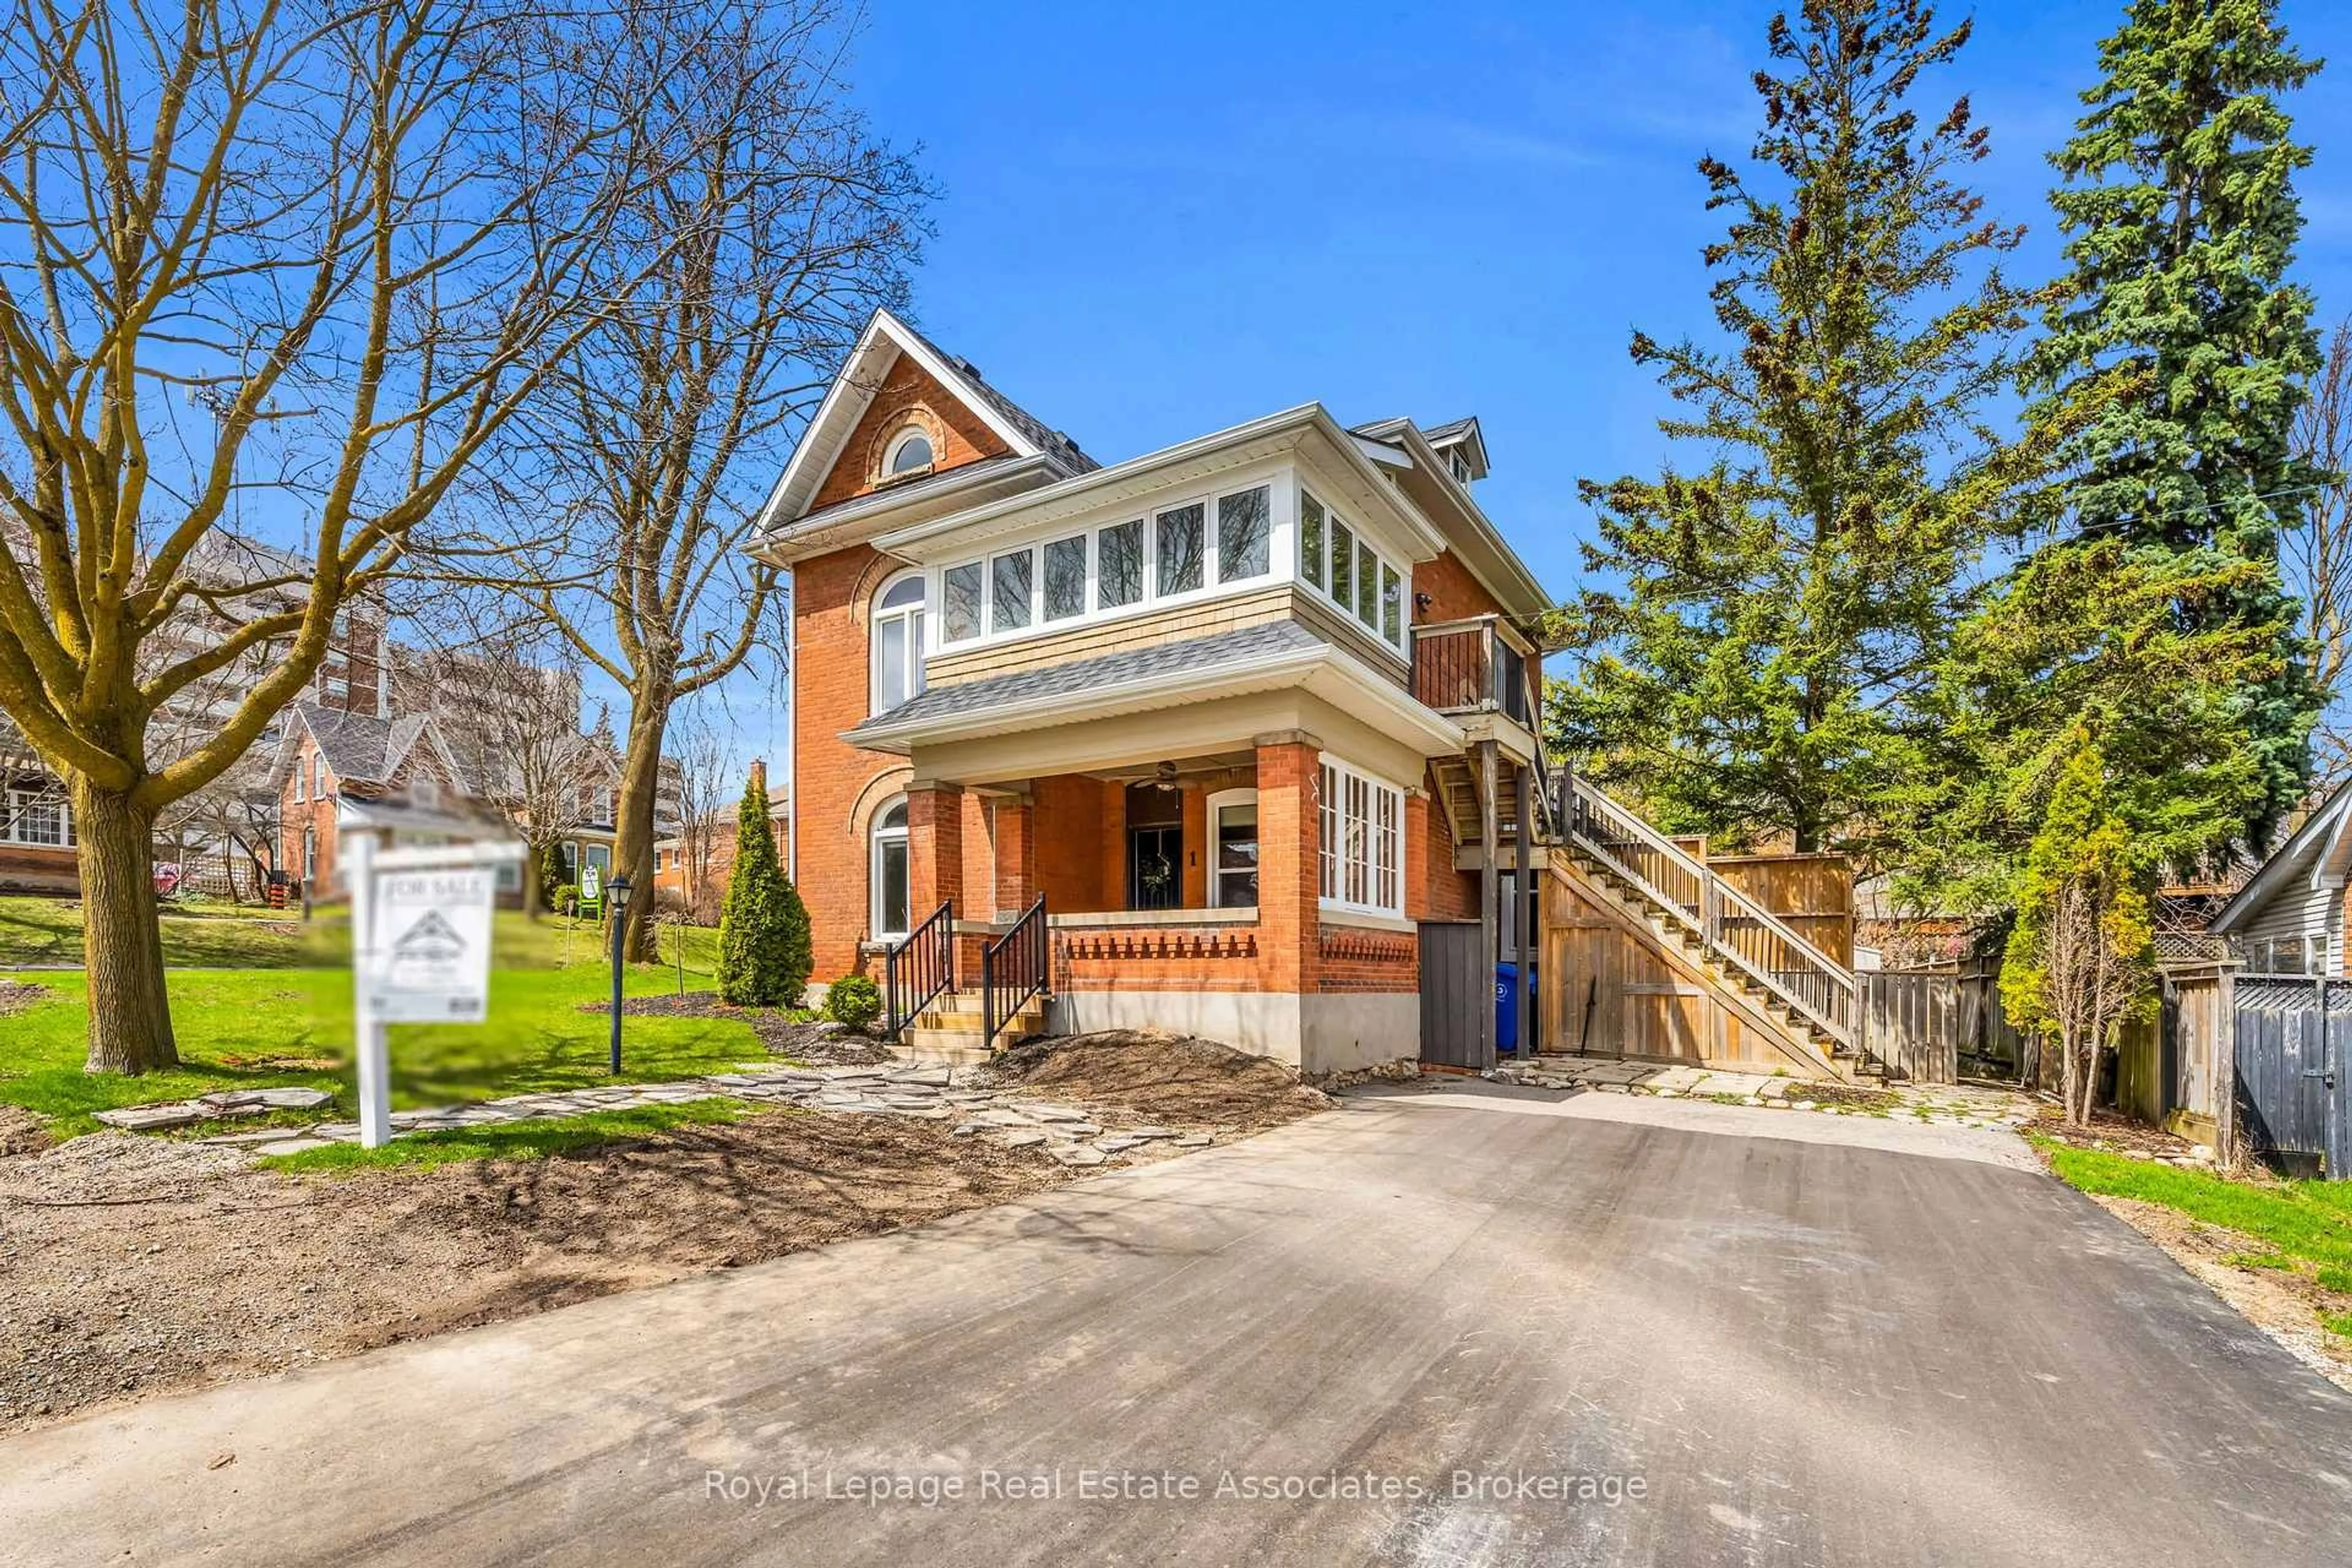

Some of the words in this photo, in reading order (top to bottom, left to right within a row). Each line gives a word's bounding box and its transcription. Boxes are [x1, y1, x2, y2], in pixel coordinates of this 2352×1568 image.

[1191, 851, 1196, 867] 1
[386, 880, 426, 896] FOR
[431, 876, 483, 894] SALE
